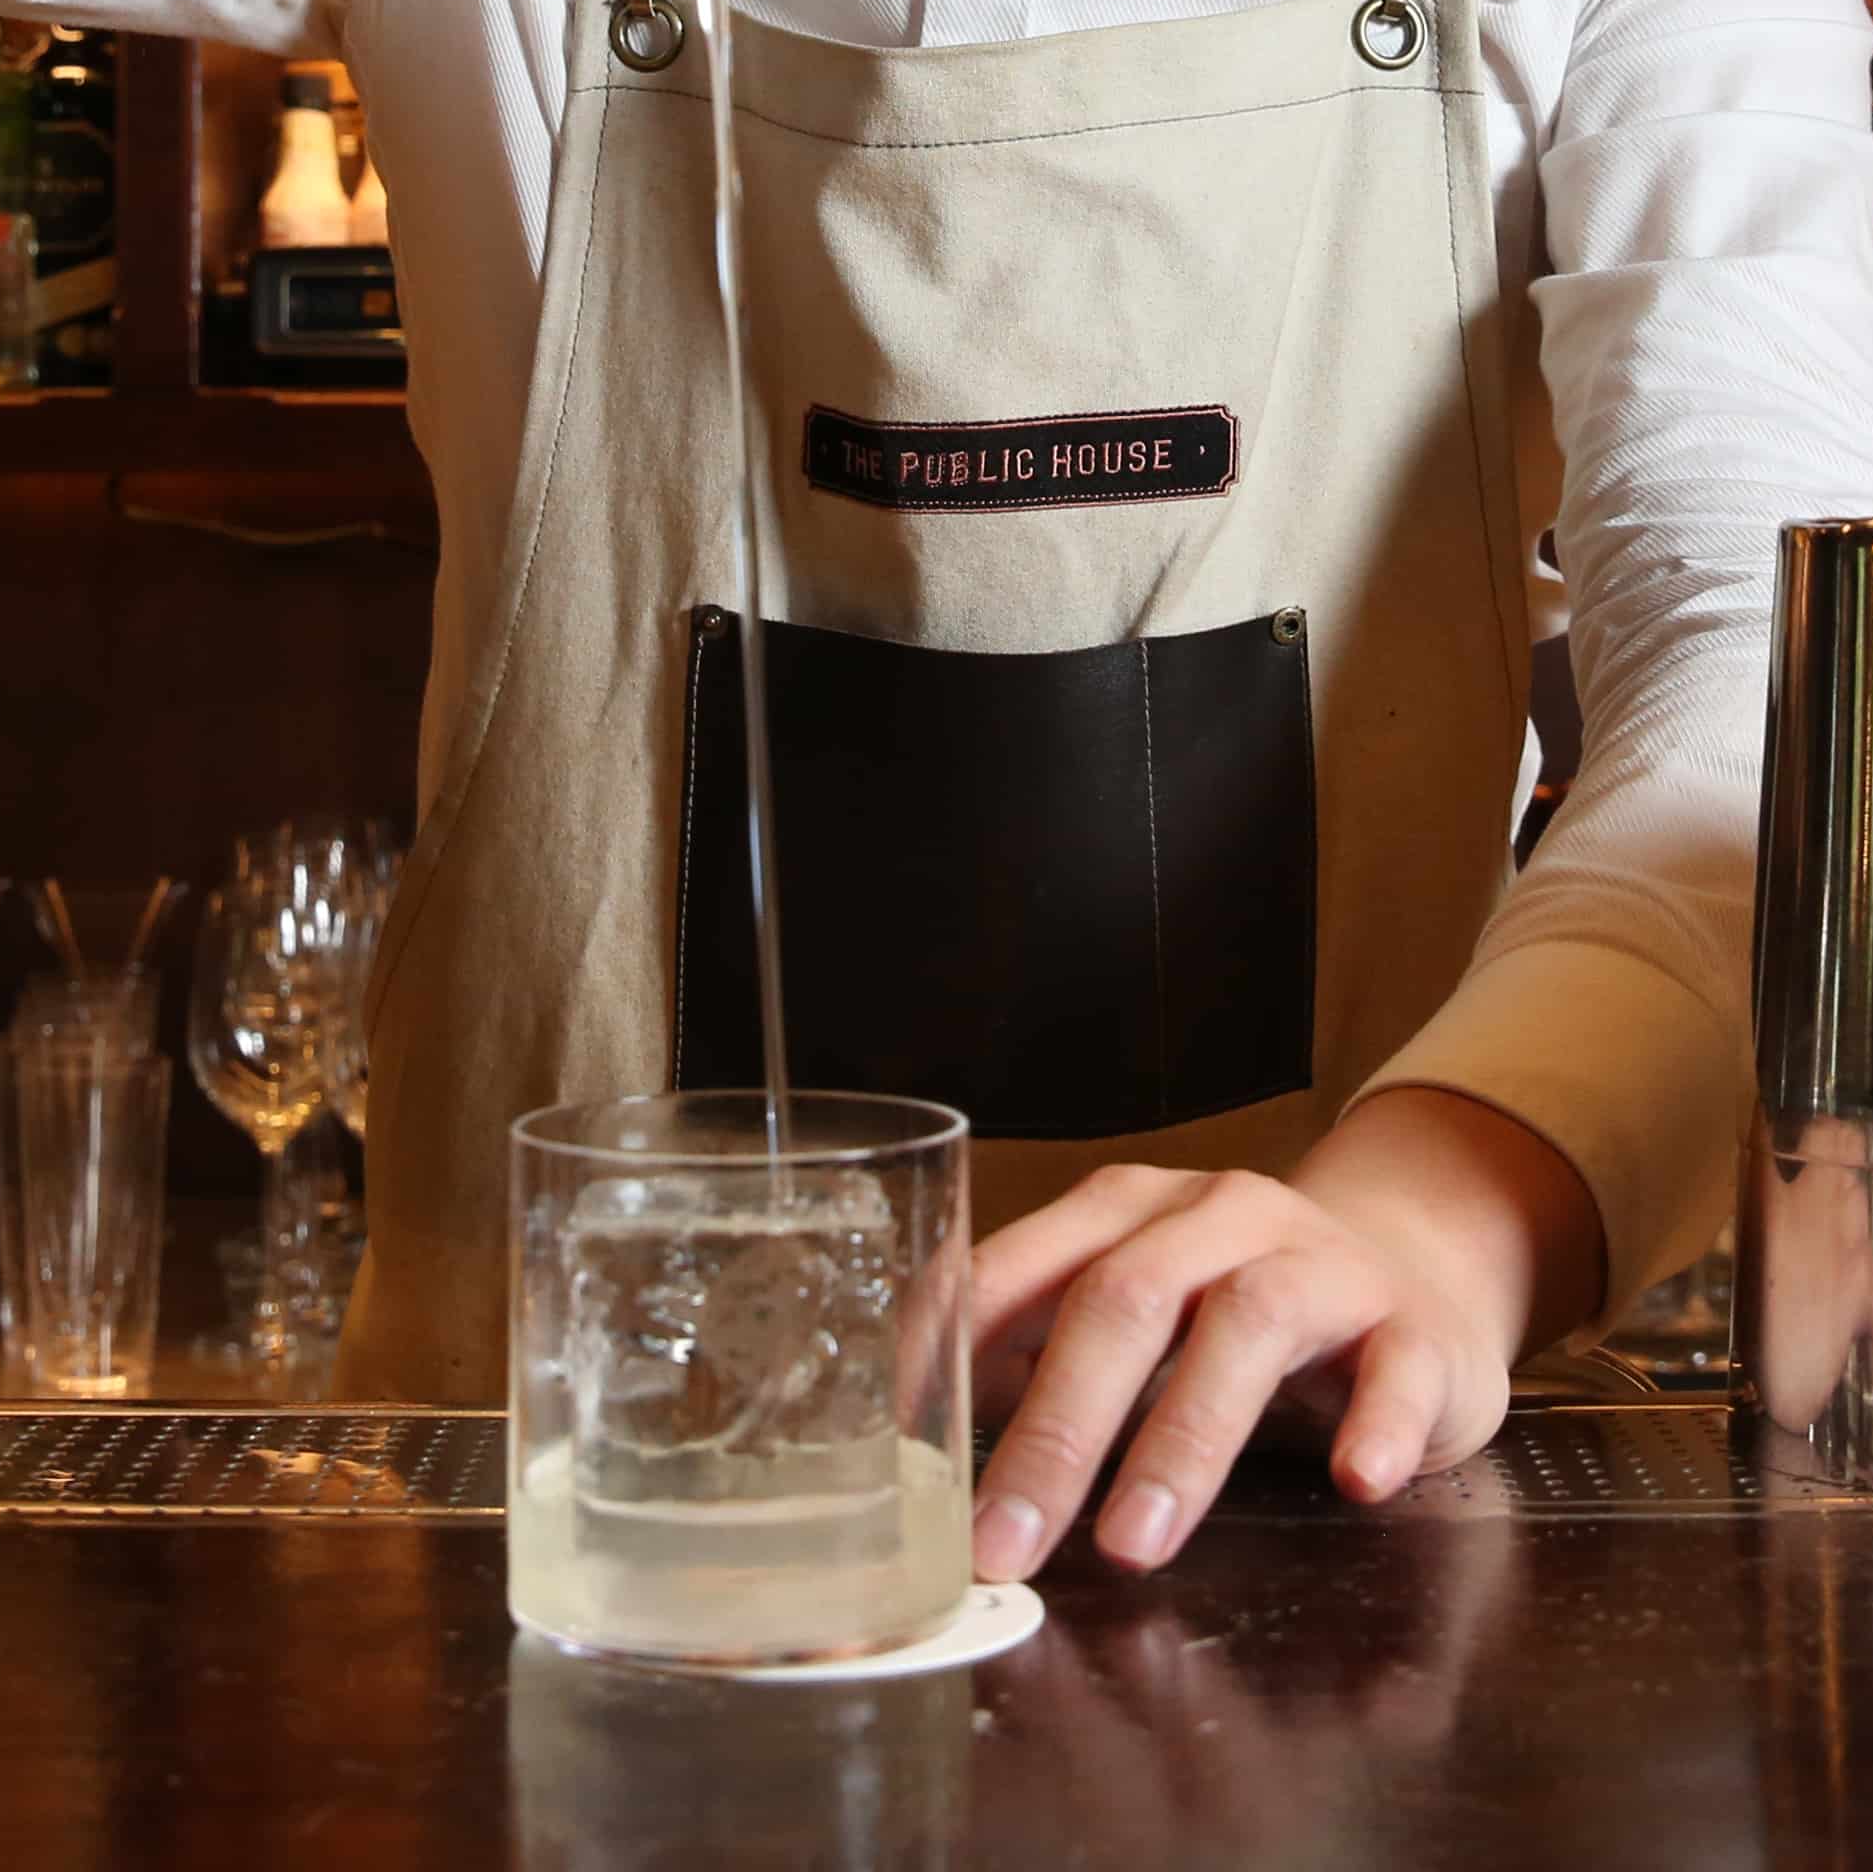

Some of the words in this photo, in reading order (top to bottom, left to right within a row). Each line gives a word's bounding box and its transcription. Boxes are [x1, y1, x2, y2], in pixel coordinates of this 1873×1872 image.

[841, 439, 883, 481] THE
[898, 446, 1036, 488] PUBLIC
[1050, 438, 1174, 480] HOUSE
